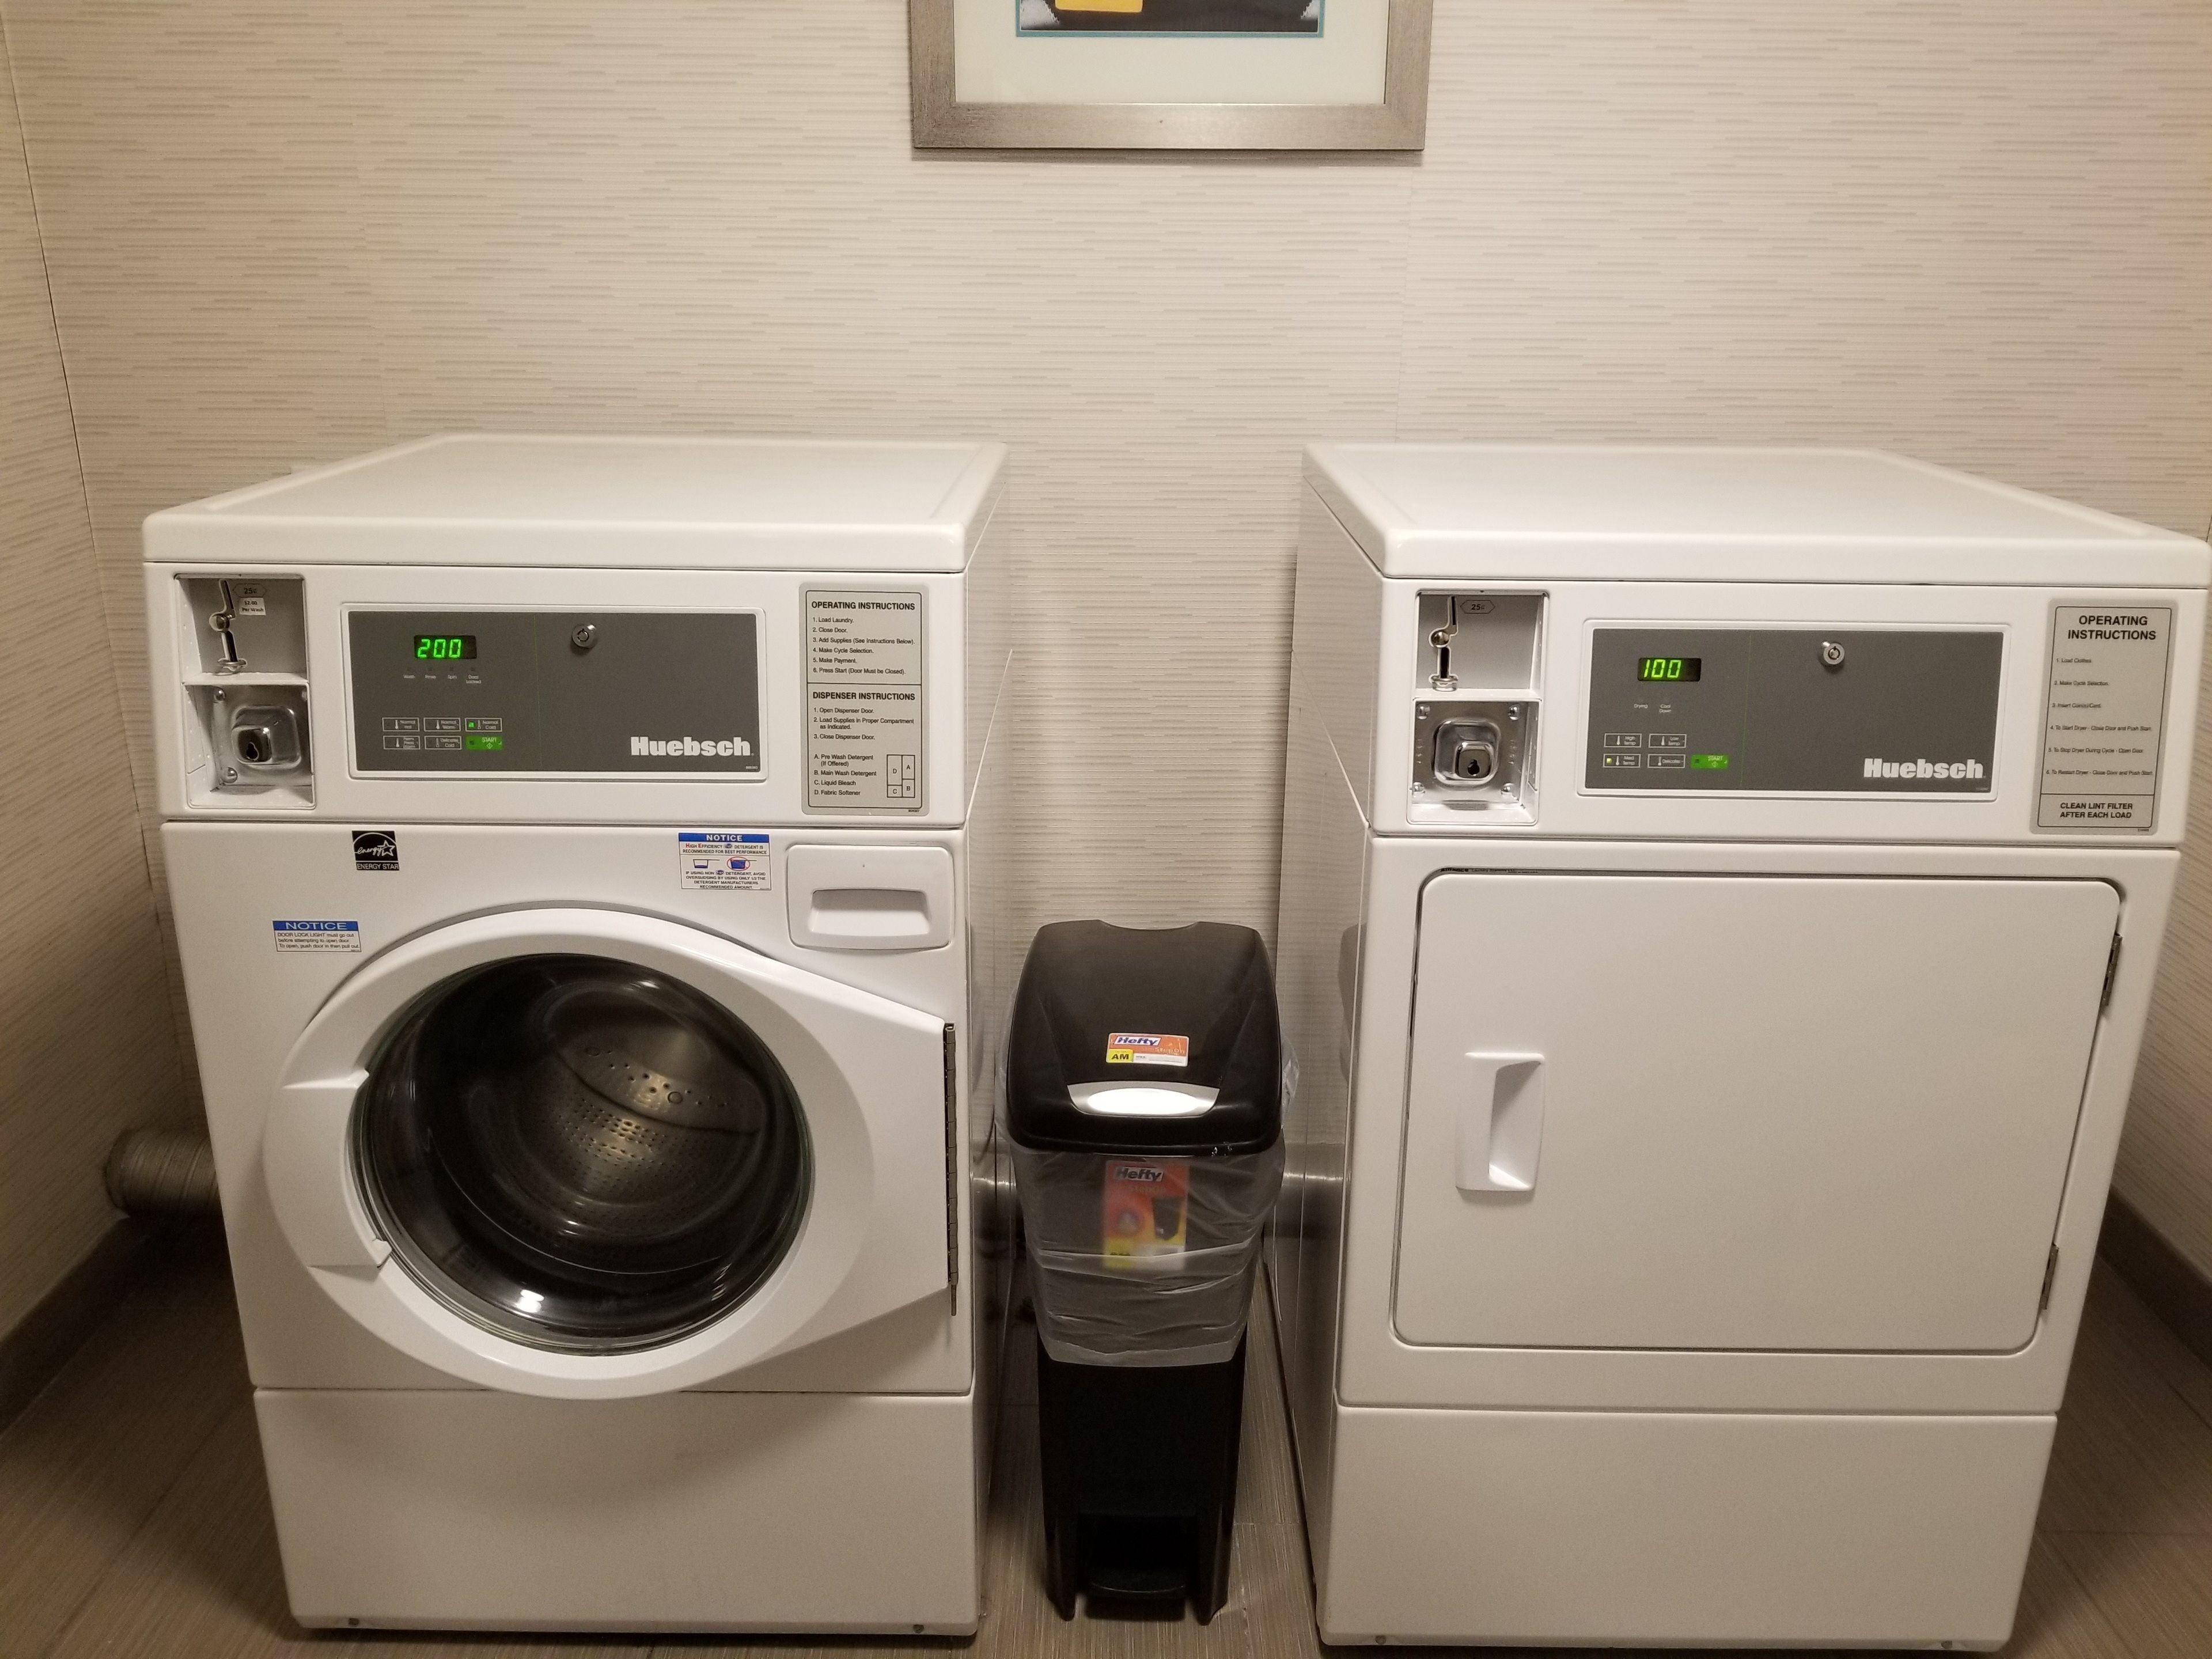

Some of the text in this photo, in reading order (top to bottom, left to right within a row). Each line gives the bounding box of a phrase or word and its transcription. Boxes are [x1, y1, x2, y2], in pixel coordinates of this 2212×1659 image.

[2079, 615, 2147, 625] OPERATING
[2068, 630, 2156, 639] INSTRUCTIONS
[418, 639, 461, 657] 200
[1644, 660, 1681, 677] 100
[631, 737, 751, 756] Huebsch
[1864, 758, 1983, 778] Huebsch
[1118, 1037, 1158, 1046] Hefty
